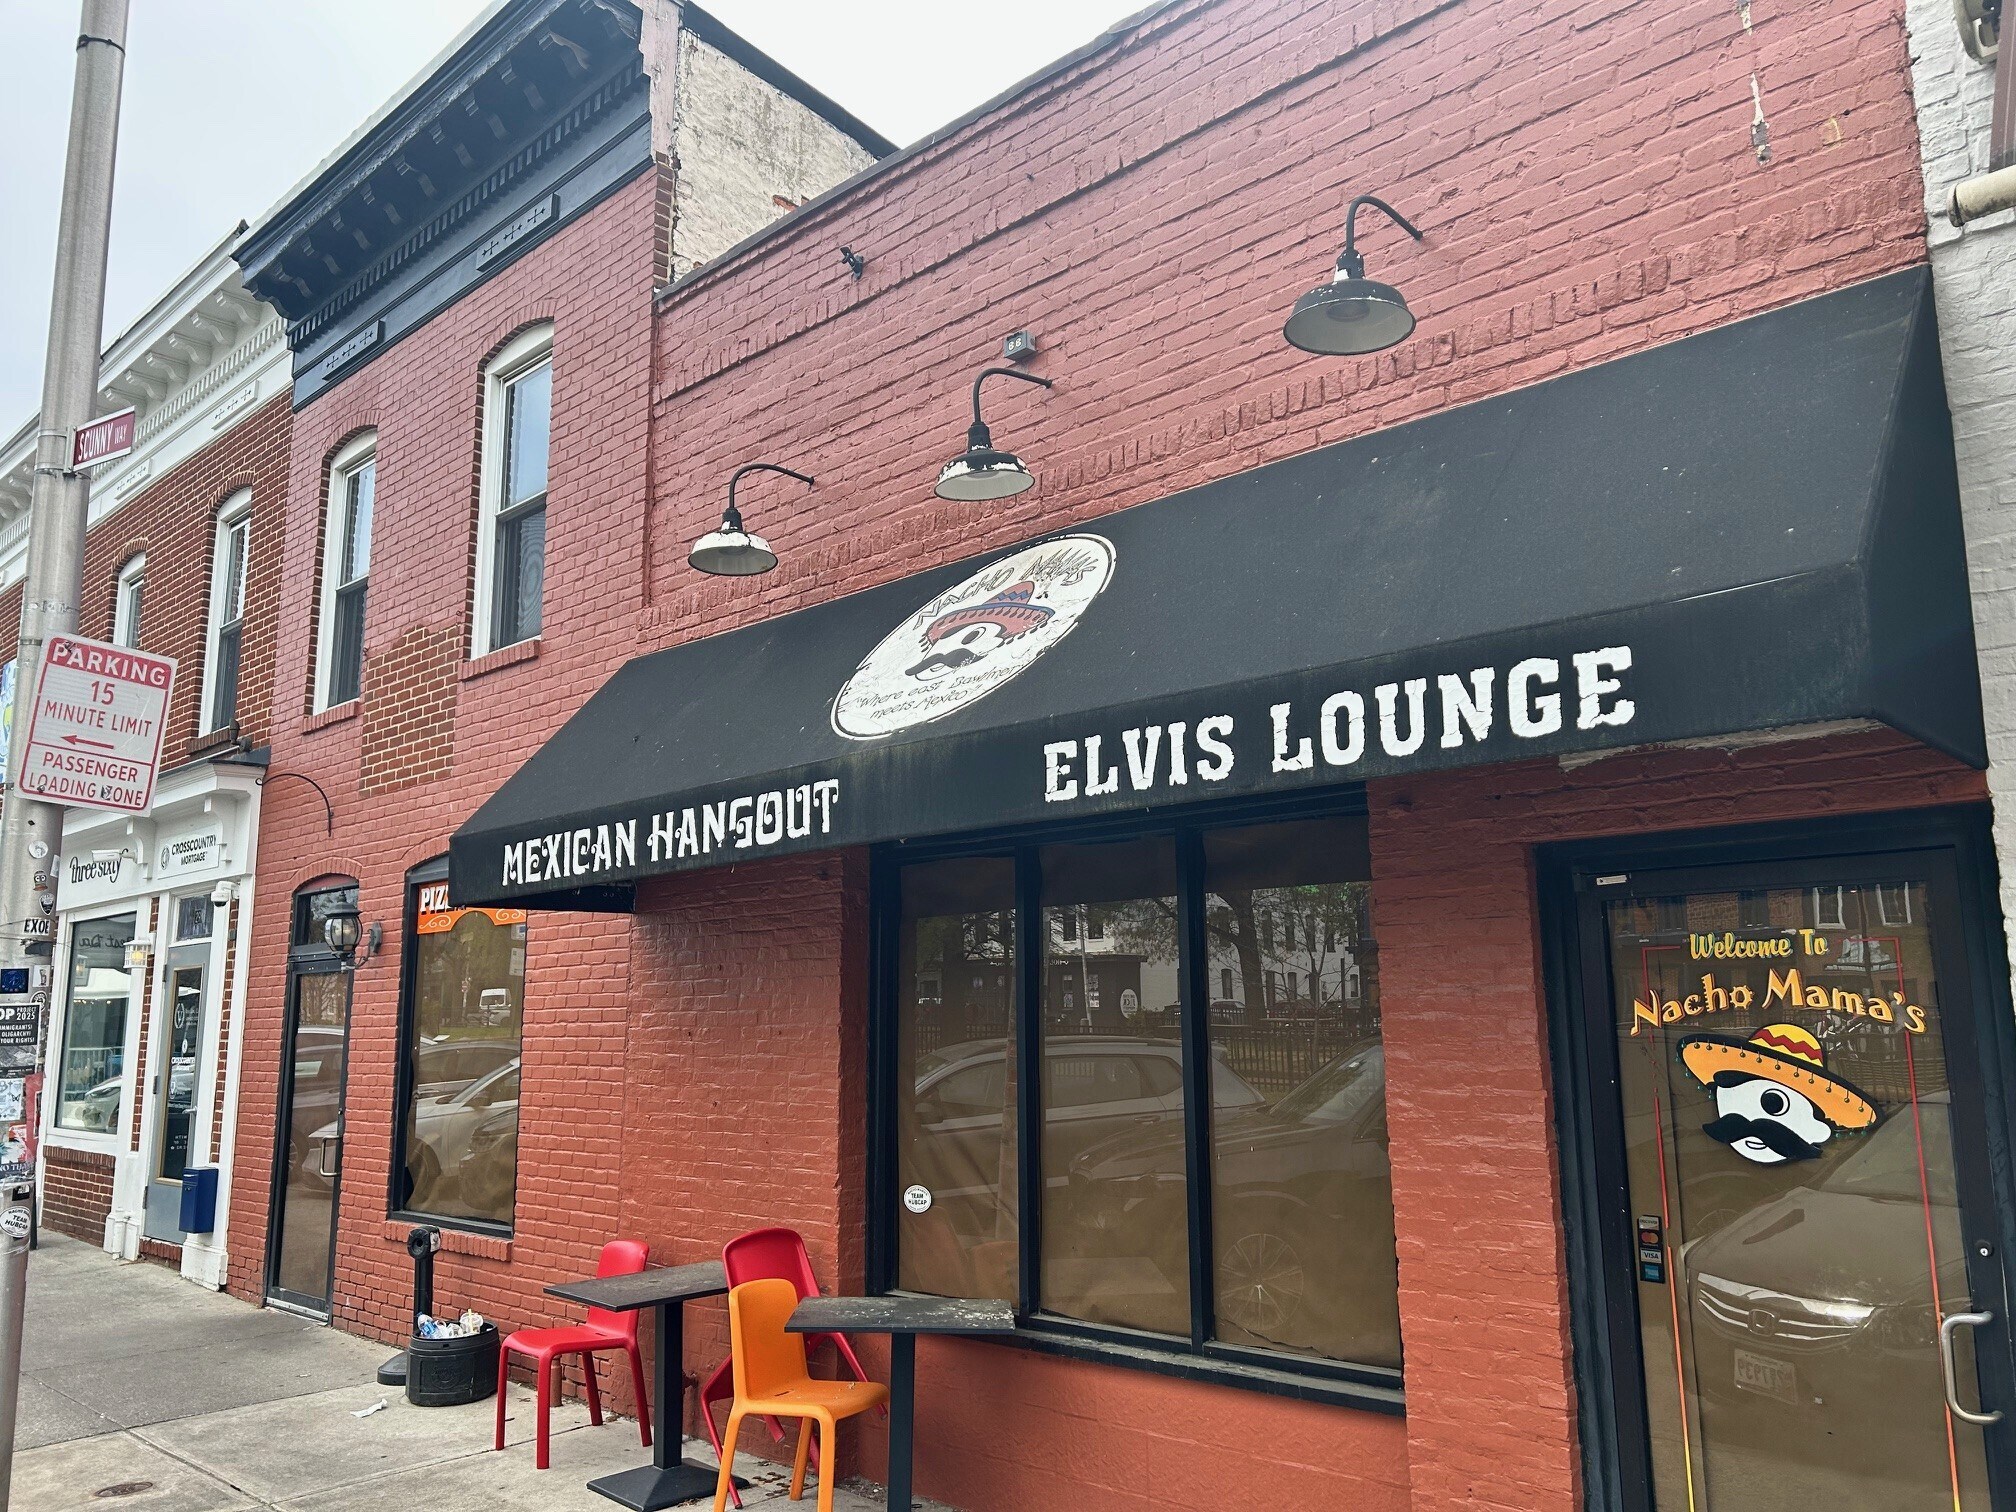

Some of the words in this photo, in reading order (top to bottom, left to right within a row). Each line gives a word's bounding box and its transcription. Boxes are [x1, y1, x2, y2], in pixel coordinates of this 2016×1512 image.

[78, 422, 114, 461] SCUNNY
[114, 424, 128, 444] WAY
[51, 642, 168, 687] PARKING
[90, 679, 116, 706] 15
[44, 699, 106, 732] MINUTE
[111, 713, 153, 739] LIMIT
[1043, 714, 1235, 803] ELVIS
[1269, 645, 1637, 774] LOUNGE
[42, 751, 139, 783] PASSENGER
[28, 772, 97, 799] LOADING
[502, 818, 637, 887] MEXICAN
[646, 778, 840, 863] HANGOUT
[1689, 931, 1793, 961] Welcome
[1798, 928, 1829, 956] To
[16, 1012, 36, 1021] 2025
[1631, 972, 1755, 1037] Nacho
[1761, 968, 1929, 1034] Mama's
[1643, 1251, 1659, 1260] VISA
